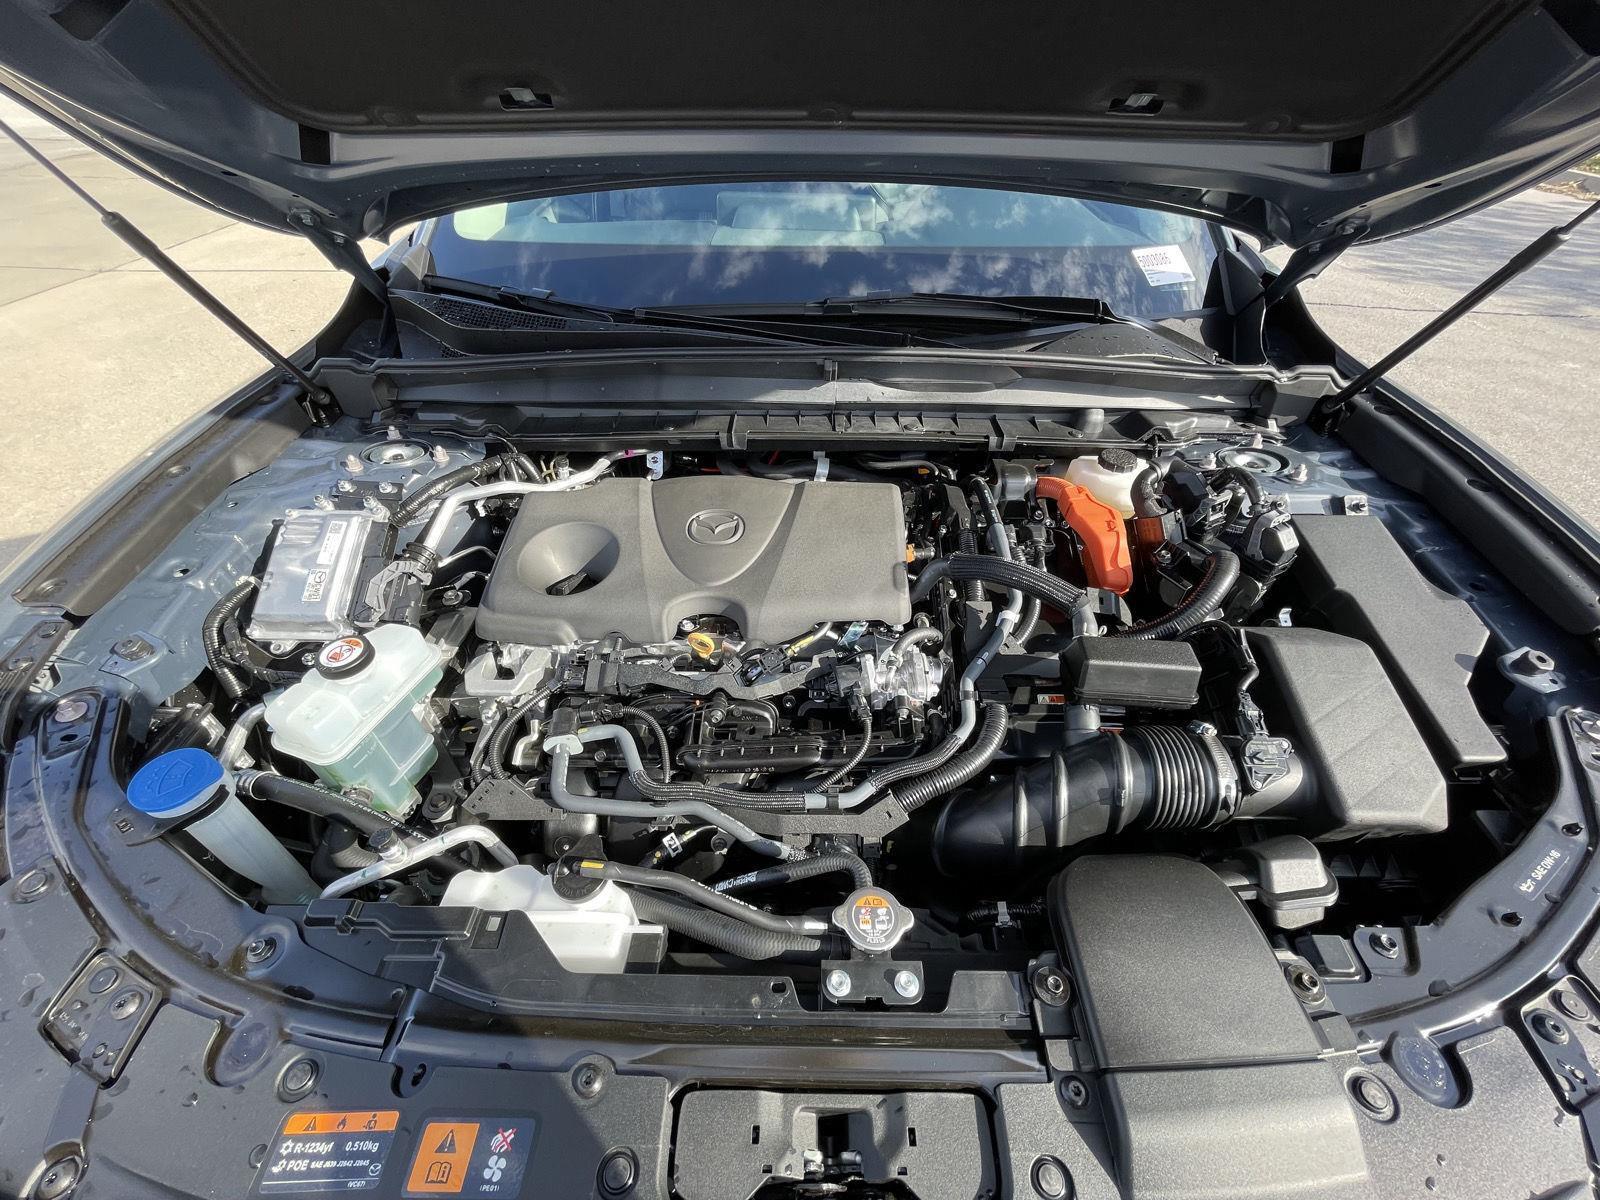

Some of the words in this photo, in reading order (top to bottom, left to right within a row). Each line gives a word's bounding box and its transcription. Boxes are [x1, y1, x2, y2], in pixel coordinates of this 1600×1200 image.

[1531, 865, 1547, 880] SAE
[294, 1141, 334, 1155] R-1234yf
[345, 1140, 380, 1153] 0.510kg
[286, 1159, 309, 1171] POE
